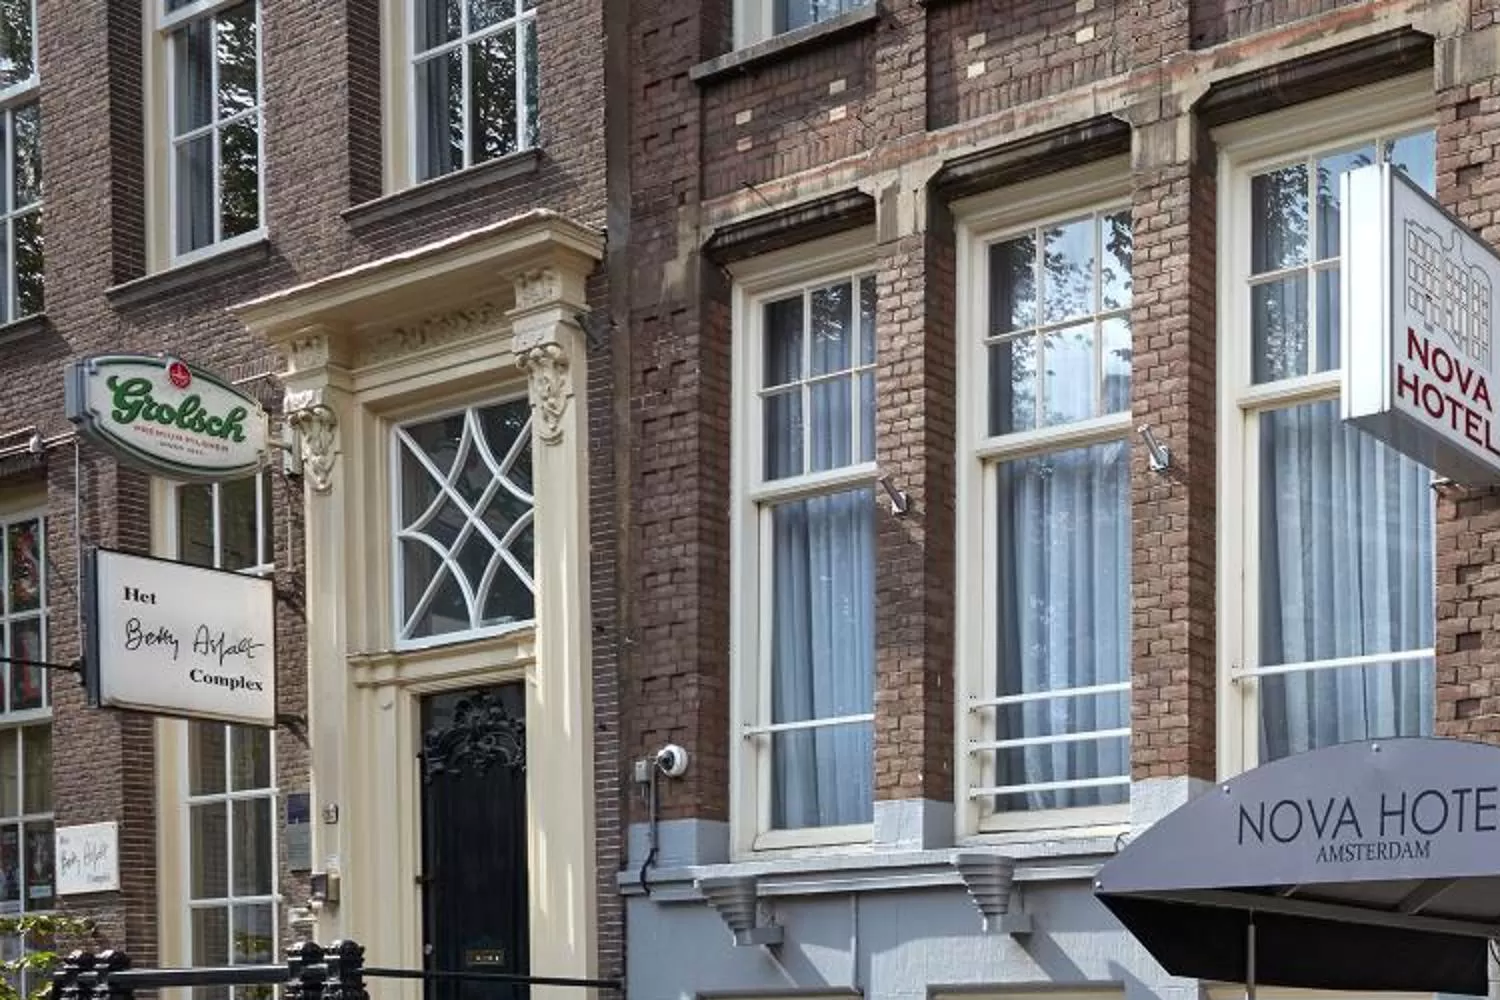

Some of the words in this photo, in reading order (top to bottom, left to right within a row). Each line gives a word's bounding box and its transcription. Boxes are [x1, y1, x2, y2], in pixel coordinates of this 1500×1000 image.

[1406, 326, 1493, 412] NOVA
[106, 375, 247, 442] Grolsch
[124, 586, 157, 605] Het
[189, 668, 263, 691] Complex
[1238, 798, 1363, 845] NOVA
[1315, 839, 1431, 864] AMSTERDAM
